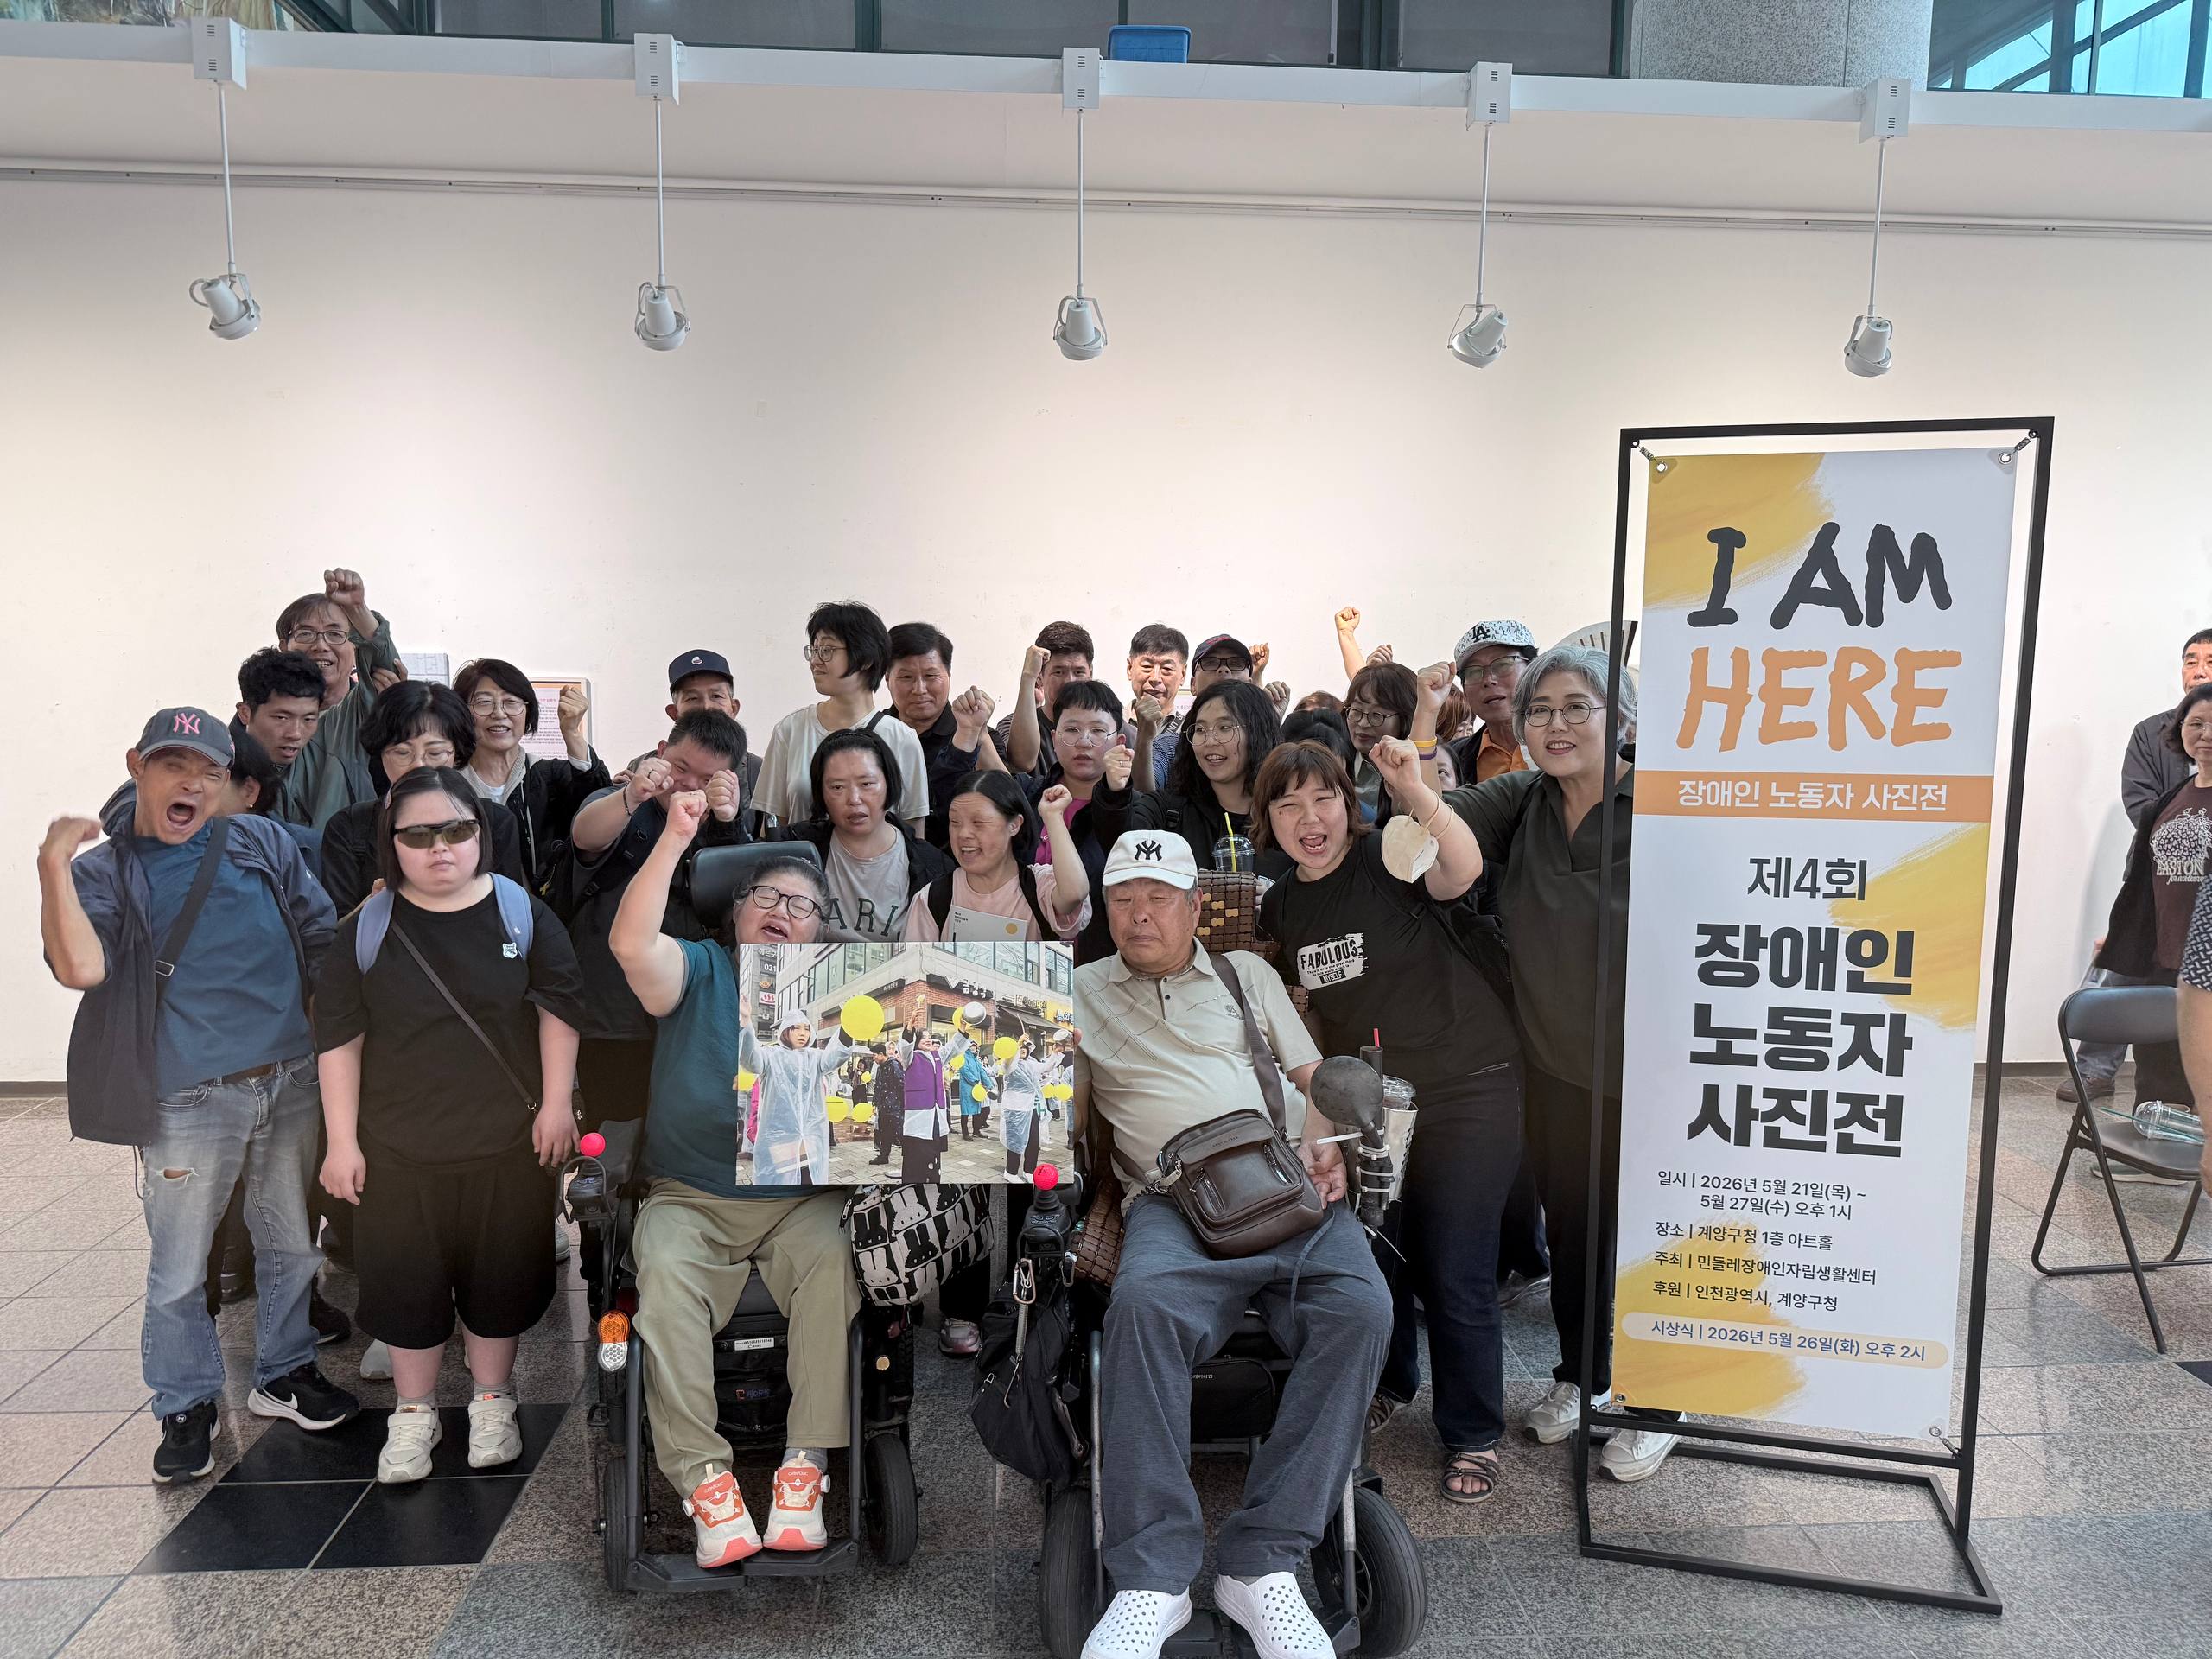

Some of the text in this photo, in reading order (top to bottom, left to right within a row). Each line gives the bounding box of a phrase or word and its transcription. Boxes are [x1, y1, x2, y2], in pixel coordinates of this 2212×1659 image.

[1687, 522, 1952, 629] I AM
[1471, 625, 1491, 643] LA
[1677, 647, 1961, 752] HERE
[173, 712, 201, 734] NY
[1679, 781, 1947, 810] 장애인 노동자 사진전
[1134, 840, 1163, 861] NY
[1748, 857, 1866, 900] 제4회
[828, 898, 901, 938] ARI
[1300, 939, 1358, 970] FABULOUS
[1695, 924, 1914, 995] 장애인
[1322, 970, 1343, 982] MYSELF
[1690, 1003, 1912, 1077] 노동자
[1688, 1084, 1904, 1157] 사진전
[1657, 1170, 1687, 1188] 일시
[1700, 1175, 1757, 1193] 2026년
[1762, 1179, 1786, 1196] 5월
[1791, 1182, 1851, 1203] 21일(목)
[1700, 1194, 1852, 1221] 5월 27일(수) 오후 1시
[1656, 1221, 1685, 1237] 장소
[1697, 1225, 1757, 1244] 계양구청
[1762, 1230, 1784, 1247] 1층
[1788, 1233, 1833, 1251] 아트홀
[1654, 1250, 1683, 1268] 주최
[1697, 1255, 1876, 1286] 민들레장애인자립생활센터
[1652, 1280, 1681, 1297] 후원
[1695, 1285, 1772, 1308] 인천광역시,
[1777, 1292, 1838, 1312] 계양구청
[1651, 1320, 1694, 1338] 시상식
[1707, 1326, 1764, 1345] 2026년
[1768, 1332, 1792, 1349] 5월
[1796, 1335, 1860, 1357] 26일(화)
[1865, 1342, 1896, 1358] 오후
[1900, 1345, 1925, 1362] 2시
